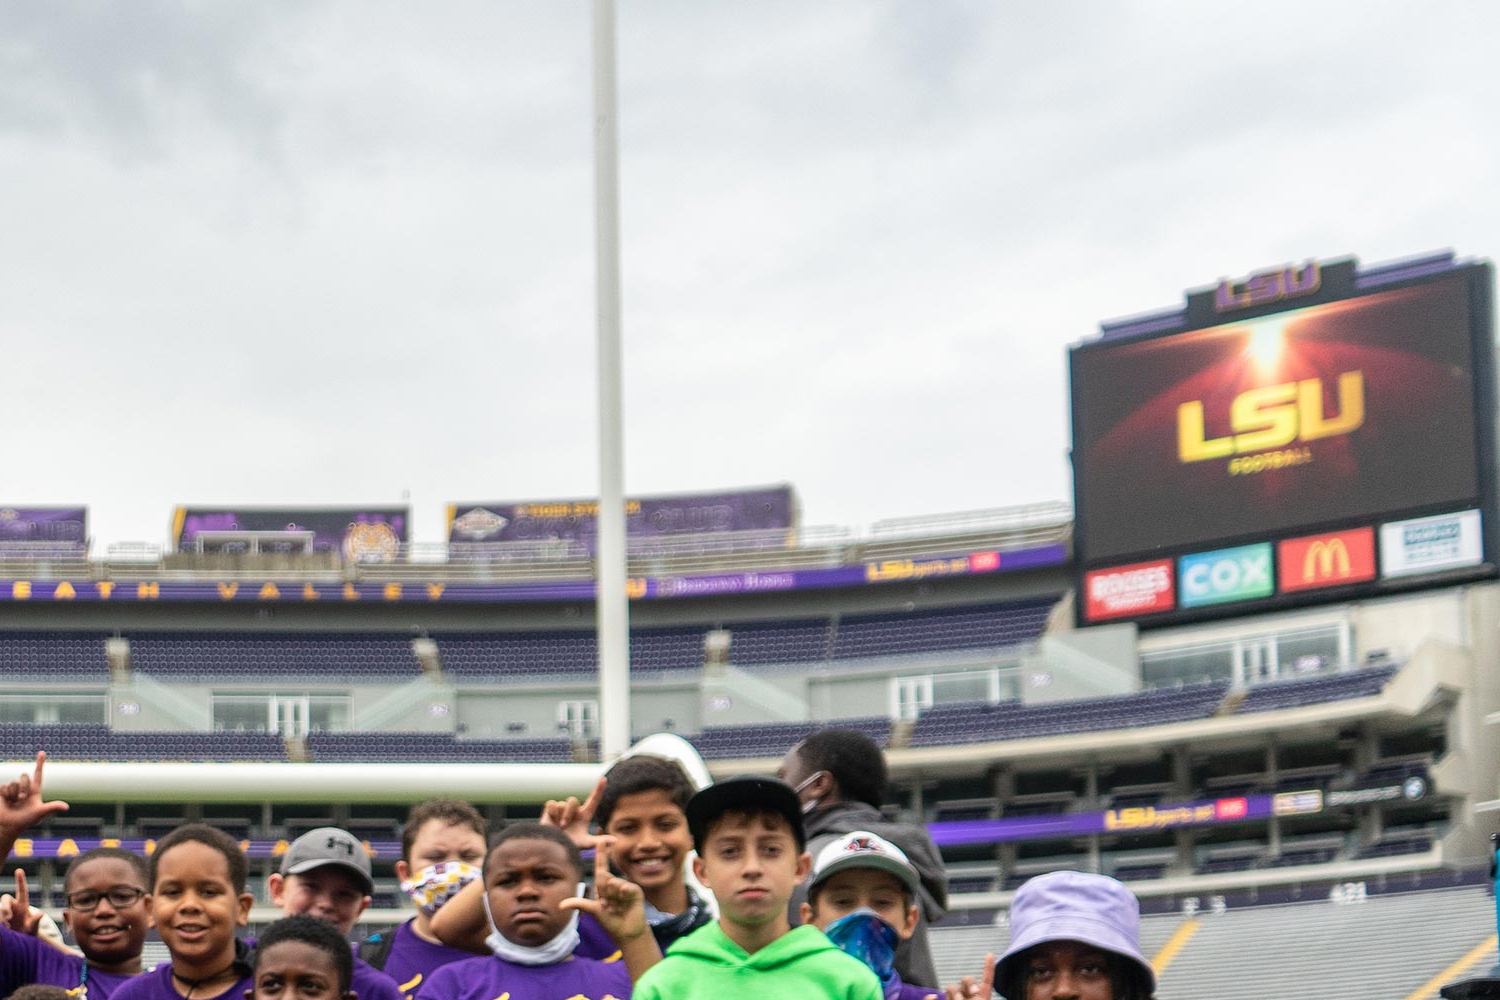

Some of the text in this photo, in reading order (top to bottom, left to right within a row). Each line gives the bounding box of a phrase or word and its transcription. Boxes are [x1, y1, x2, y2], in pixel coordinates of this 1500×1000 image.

[1214, 260, 1322, 313] LSU
[1177, 369, 1365, 464] LSU
[1228, 448, 1312, 477] FOOTBALL
[217, 582, 445, 600] VALLEY
[1184, 556, 1268, 595] COX
